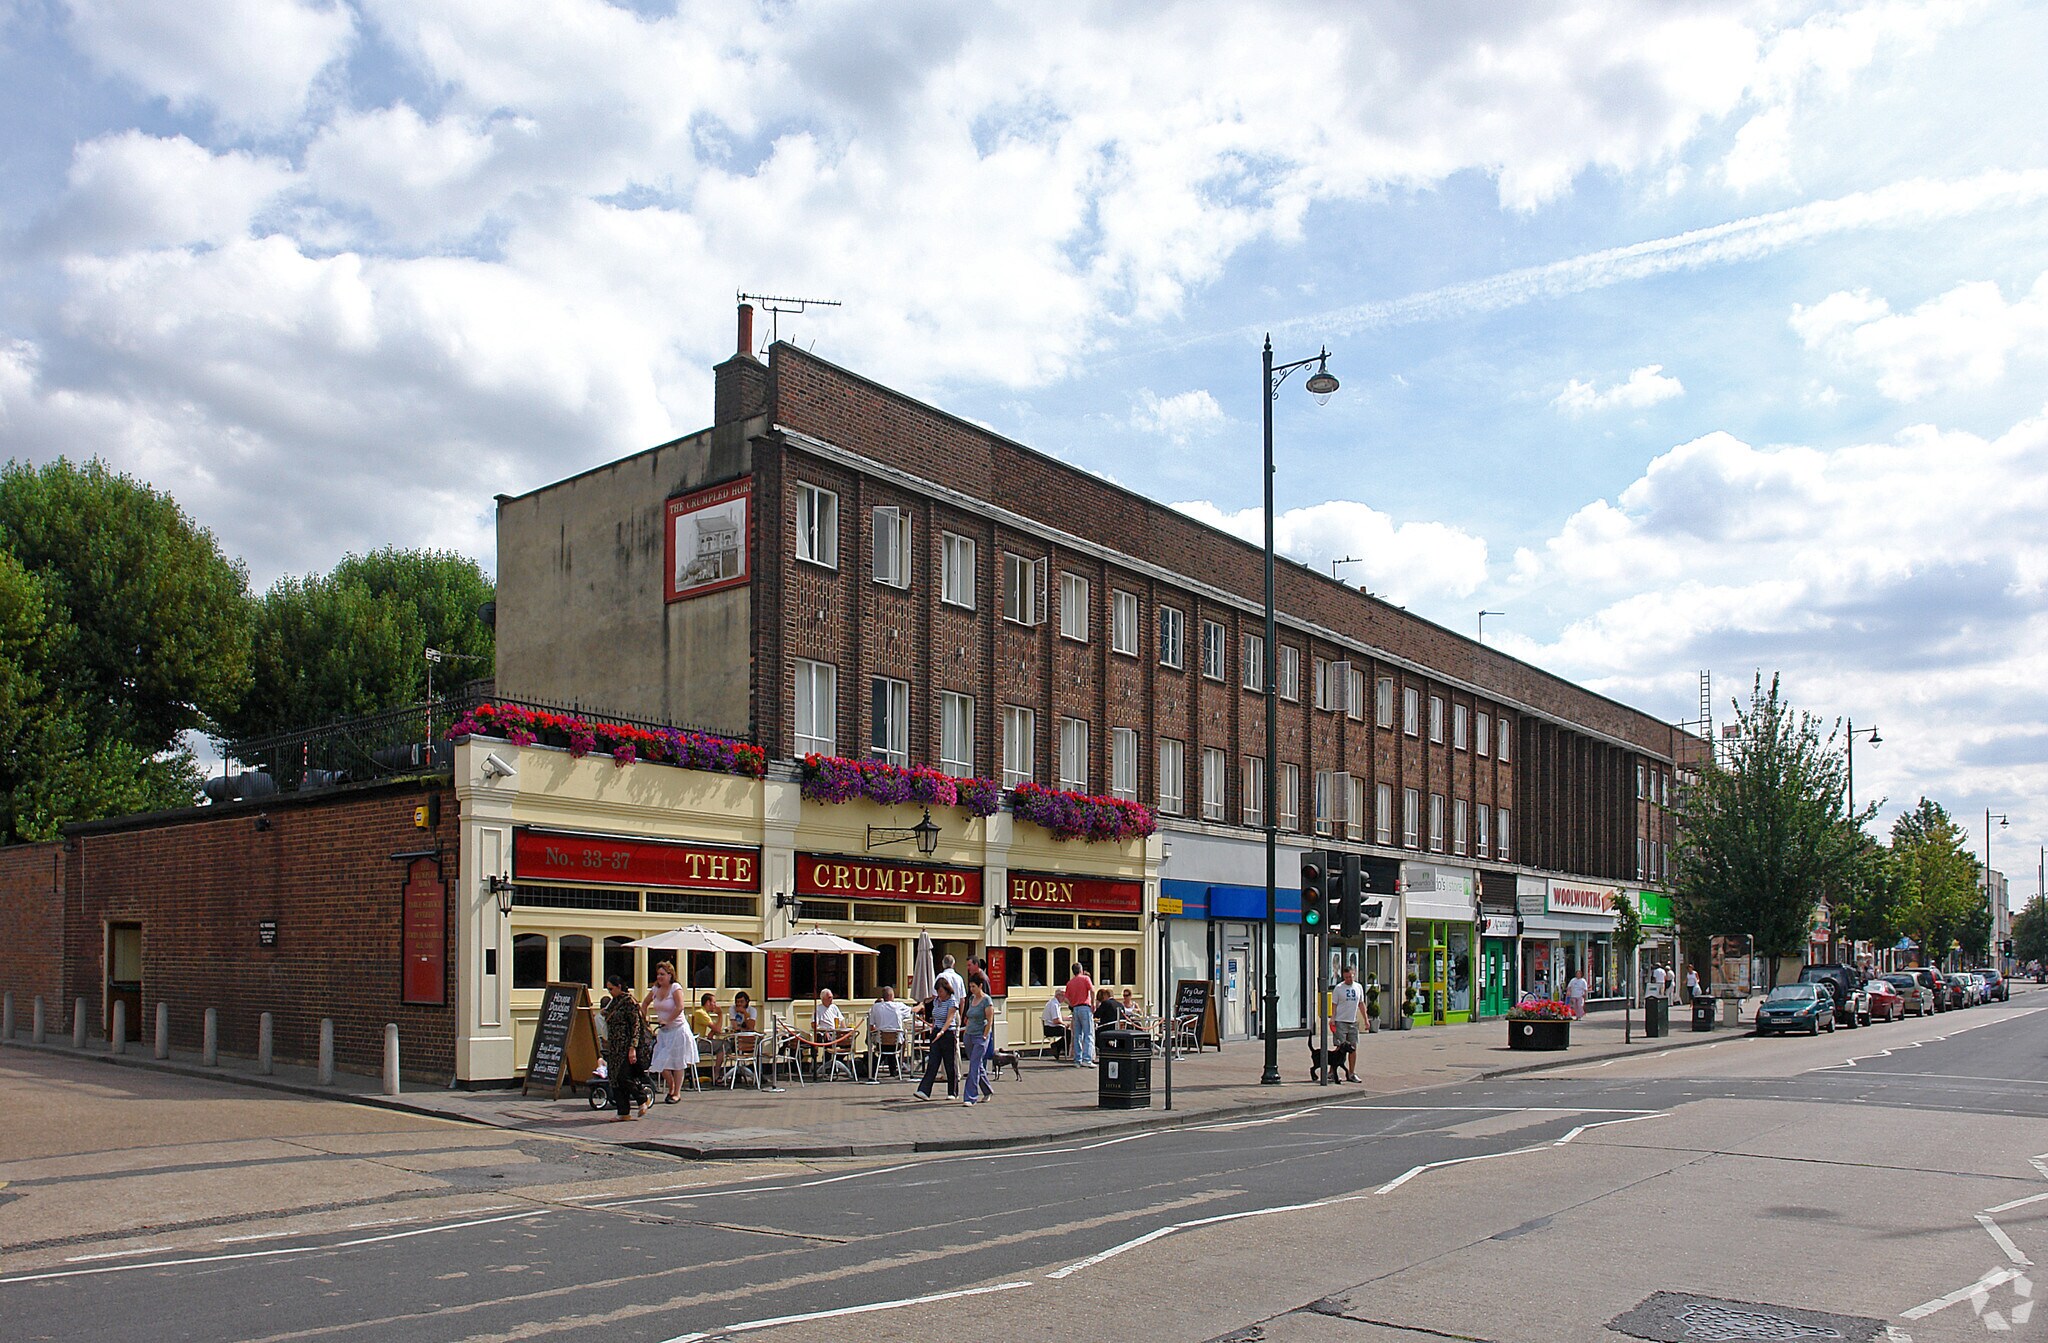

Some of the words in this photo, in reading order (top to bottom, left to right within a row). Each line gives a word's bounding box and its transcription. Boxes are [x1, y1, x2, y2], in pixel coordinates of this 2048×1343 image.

[669, 502, 684, 514] THE
[687, 488, 729, 509] CRUMPLED
[545, 846, 575, 867] No.
[582, 848, 631, 870] 33-37
[685, 853, 752, 882] THE
[813, 863, 966, 896] CRUMPLED
[1012, 879, 1074, 903] HORN
[1553, 887, 1601, 909] WOOLWORTHS
[553, 992, 571, 1003] House
[1181, 996, 1204, 1004] Delicious
[1183, 987, 1192, 996] Try
[1193, 988, 1205, 996] Our
[1346, 989, 1356, 998] 29
[548, 1001, 570, 1013] Doubles
